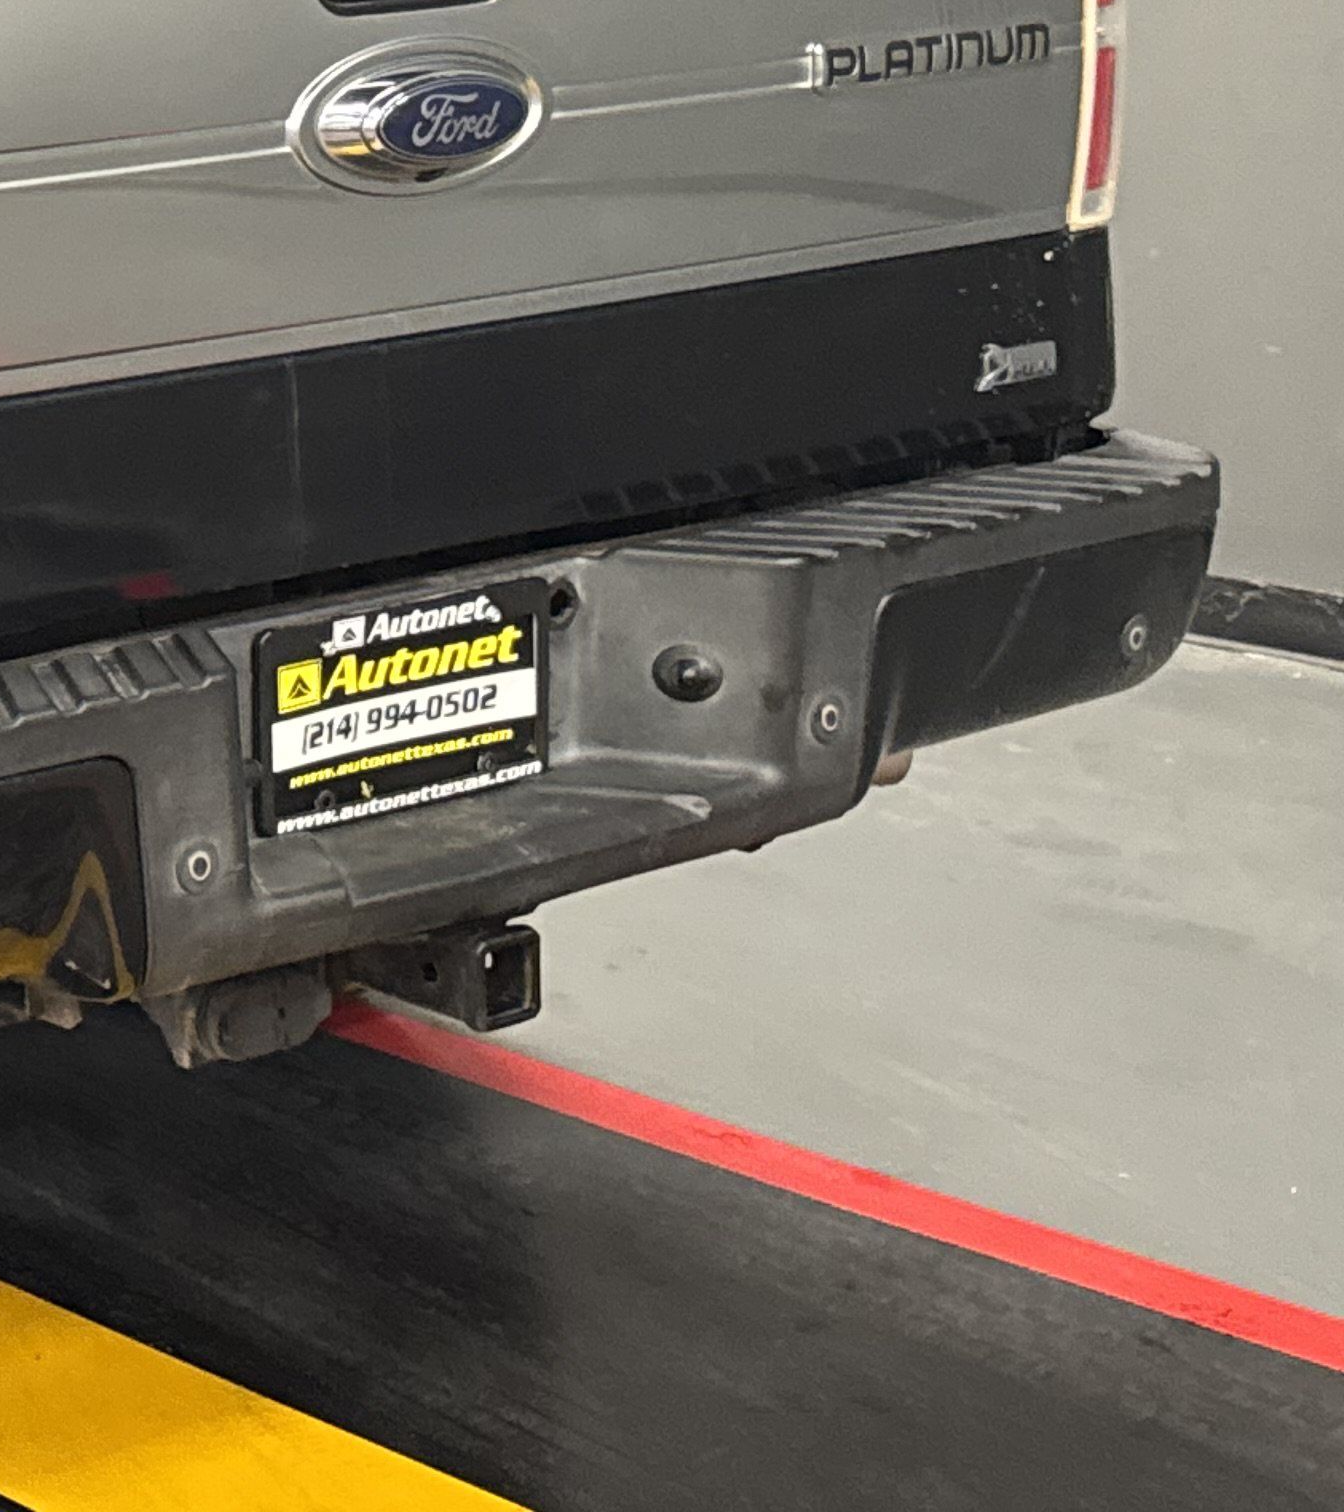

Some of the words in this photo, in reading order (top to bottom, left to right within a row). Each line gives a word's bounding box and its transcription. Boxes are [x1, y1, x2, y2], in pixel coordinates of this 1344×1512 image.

[824, 22, 1051, 87] PLATINUM
[412, 92, 502, 148] Ford
[365, 594, 495, 645] Autonet
[322, 624, 524, 701] Autonet
[301, 710, 359, 756] (214)
[365, 684, 498, 734] 994-0502
[288, 727, 515, 790] www.autonettexas.com
[276, 760, 544, 835] www.autonettexas.com
